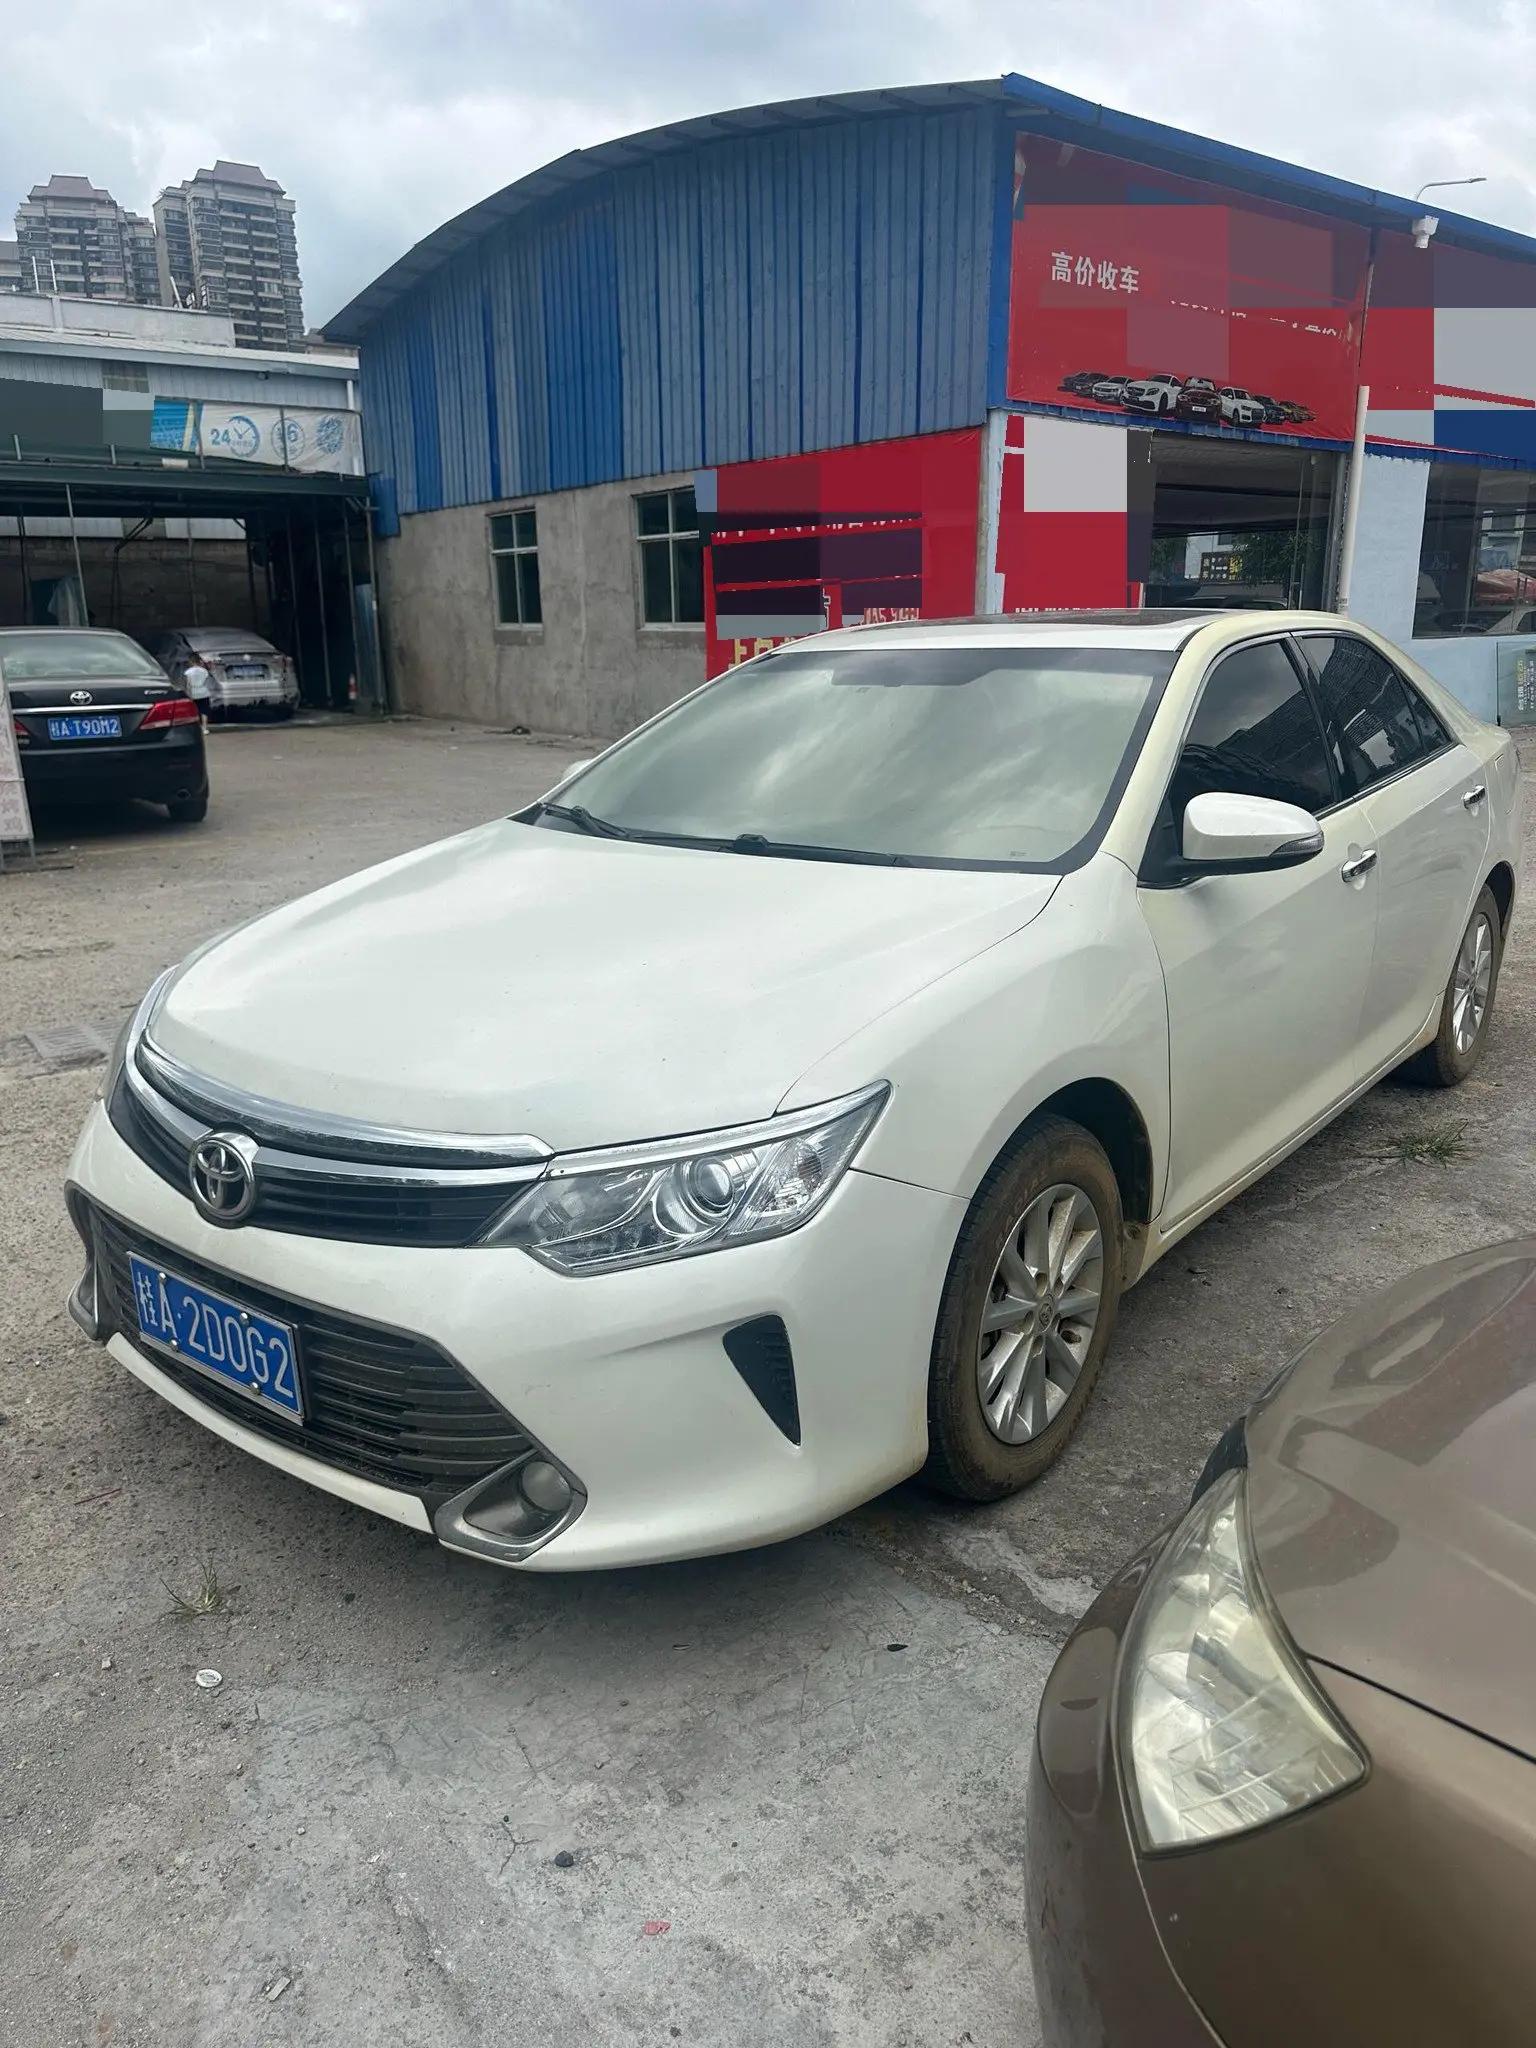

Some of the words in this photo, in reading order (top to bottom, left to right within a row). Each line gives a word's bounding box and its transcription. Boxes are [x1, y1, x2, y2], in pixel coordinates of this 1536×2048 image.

[1051, 251, 1139, 293] 高价收车
[210, 428, 231, 446] 24
